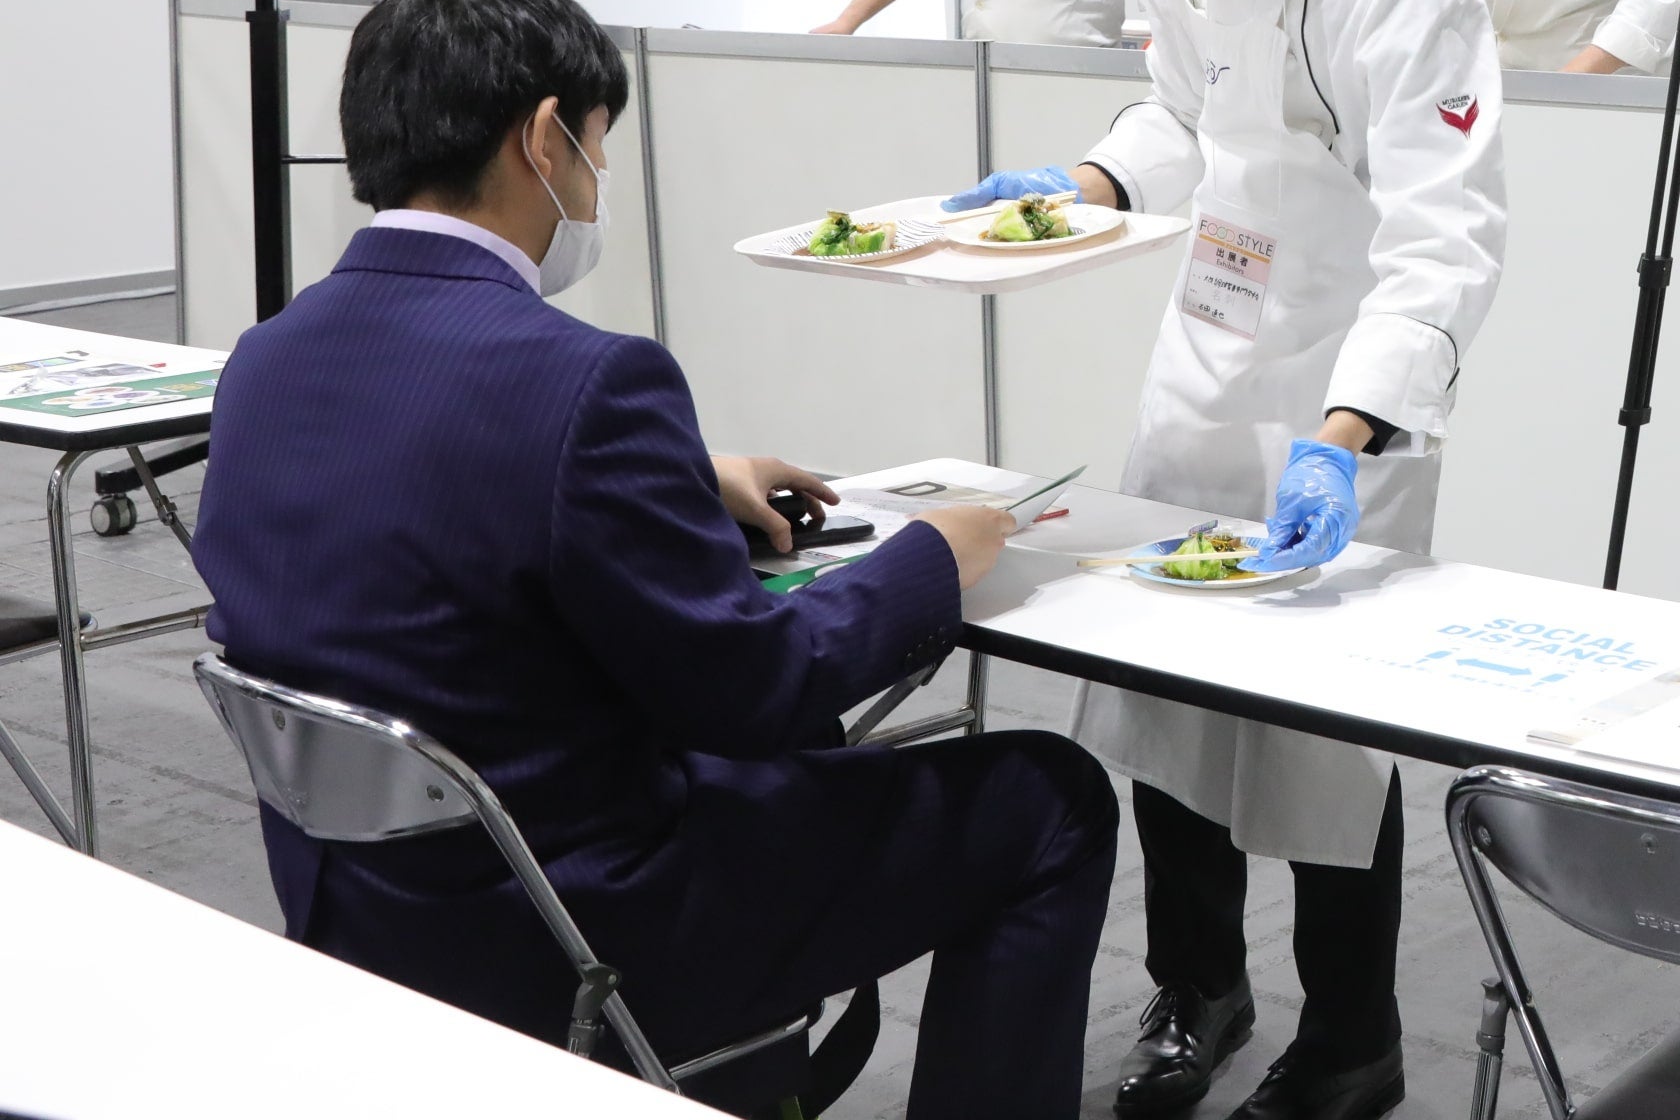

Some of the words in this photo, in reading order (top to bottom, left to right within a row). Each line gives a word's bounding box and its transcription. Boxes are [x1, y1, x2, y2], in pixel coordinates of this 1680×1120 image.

[1199, 219, 1236, 243] FOOD
[1236, 233, 1274, 258] STYLE
[1216, 247, 1249, 267] 出展者
[1216, 258, 1245, 275] Exhibitors
[1437, 624, 1658, 672] DISTANCE
[1483, 618, 1637, 655] SOCIAL
